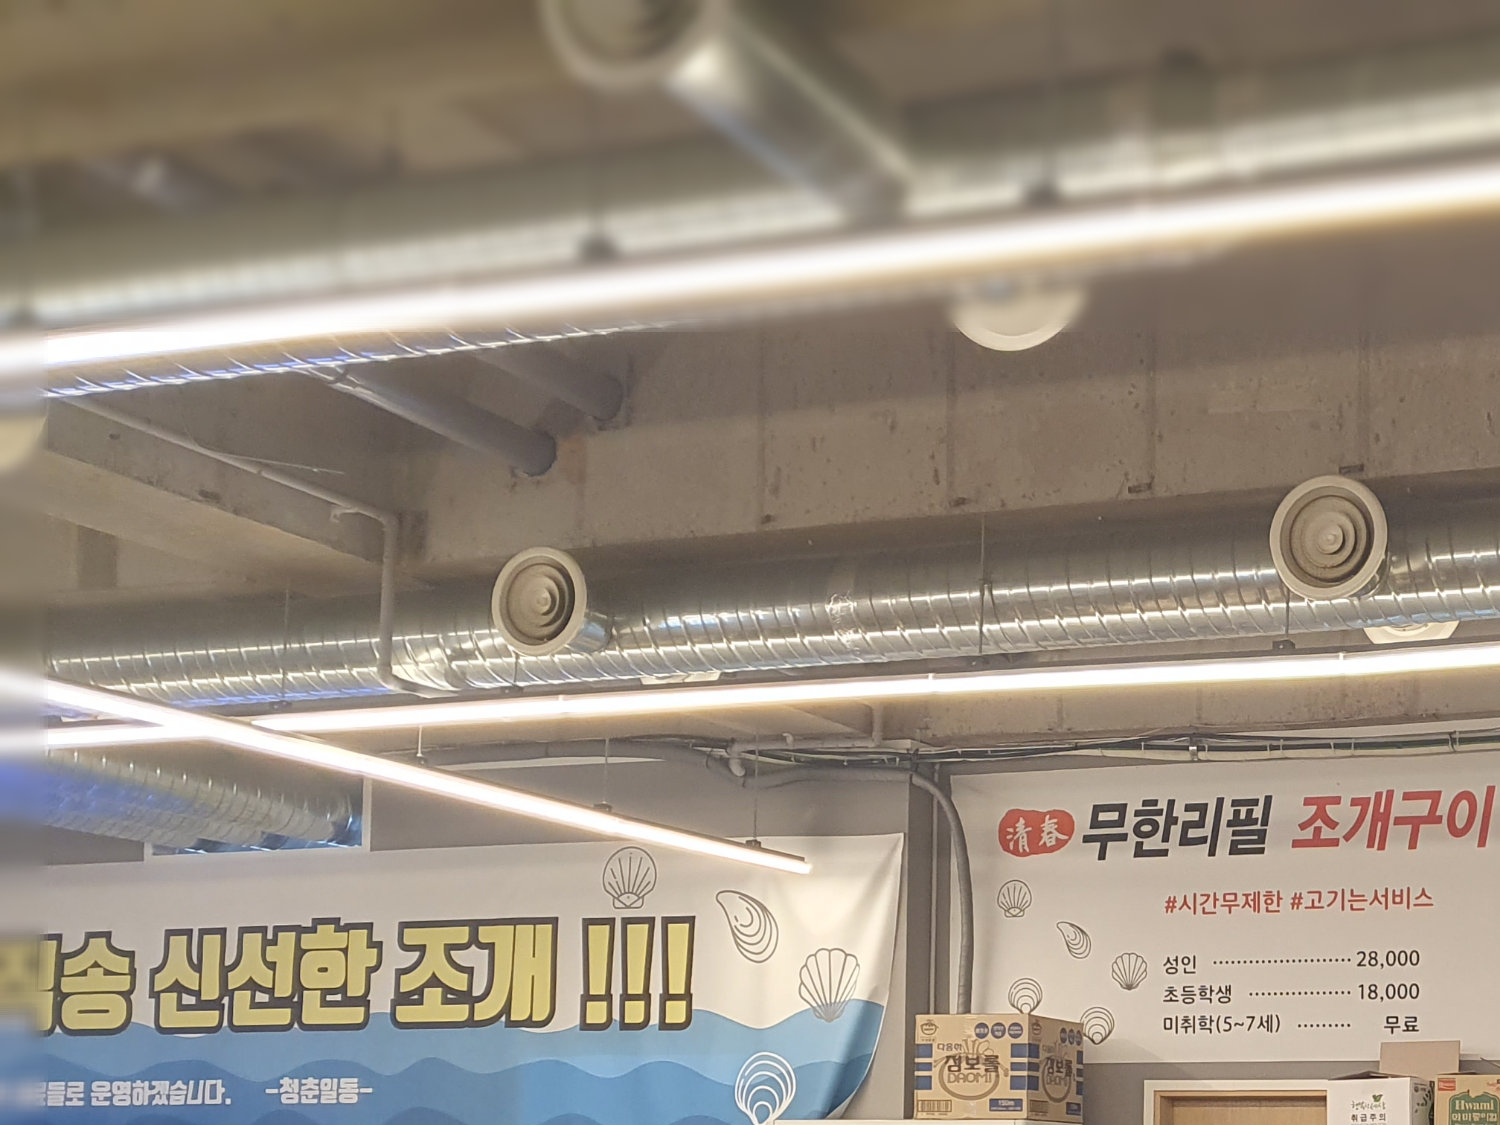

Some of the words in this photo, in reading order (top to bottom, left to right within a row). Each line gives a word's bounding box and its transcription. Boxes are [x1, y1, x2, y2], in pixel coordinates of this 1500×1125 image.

[1082, 795, 1273, 861] 무한리필
[1291, 785, 1496, 851] 조개구이
[1164, 890, 1283, 916] #시간무제한
[1290, 886, 1434, 912] #고기는서비스
[1163, 955, 1197, 975] 성인
[1356, 950, 1420, 969] 28,000
[149, 917, 383, 1035] 신선한
[390, 916, 559, 1030] 조개
[579, 915, 696, 1031] !!!
[1163, 984, 1232, 1004] 초등학생
[1358, 983, 1420, 1002] 18,000
[1163, 1014, 1281, 1034] 미취학(5~7세)
[1384, 1016, 1420, 1034] 무료
[945, 1054, 1000, 1073] 점보롤
[947, 1072, 992, 1083] DAOMI
[91, 1079, 232, 1107] 운영하겠습니다.
[265, 1077, 373, 1105] -청춘일동-
[1455, 1100, 1494, 1110] Hwami
